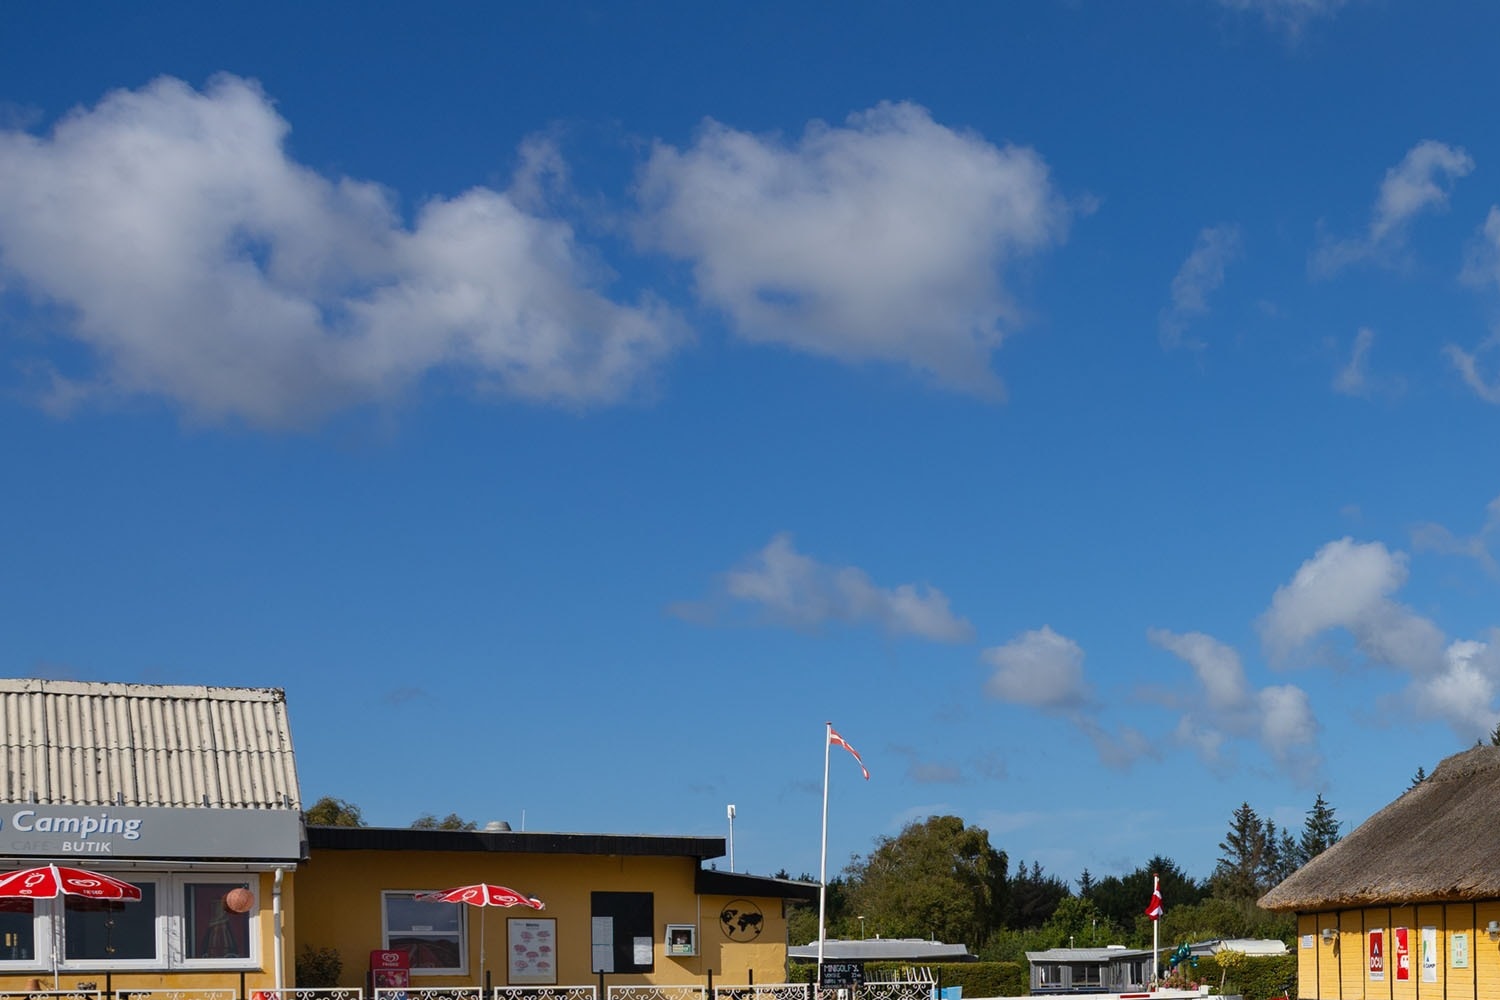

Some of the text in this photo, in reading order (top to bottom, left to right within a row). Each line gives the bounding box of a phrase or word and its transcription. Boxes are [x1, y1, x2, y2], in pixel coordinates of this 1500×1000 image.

[12, 810, 141, 840] Camping
[62, 841, 111, 852] BUTIK
[1370, 956, 1382, 968] DCU
